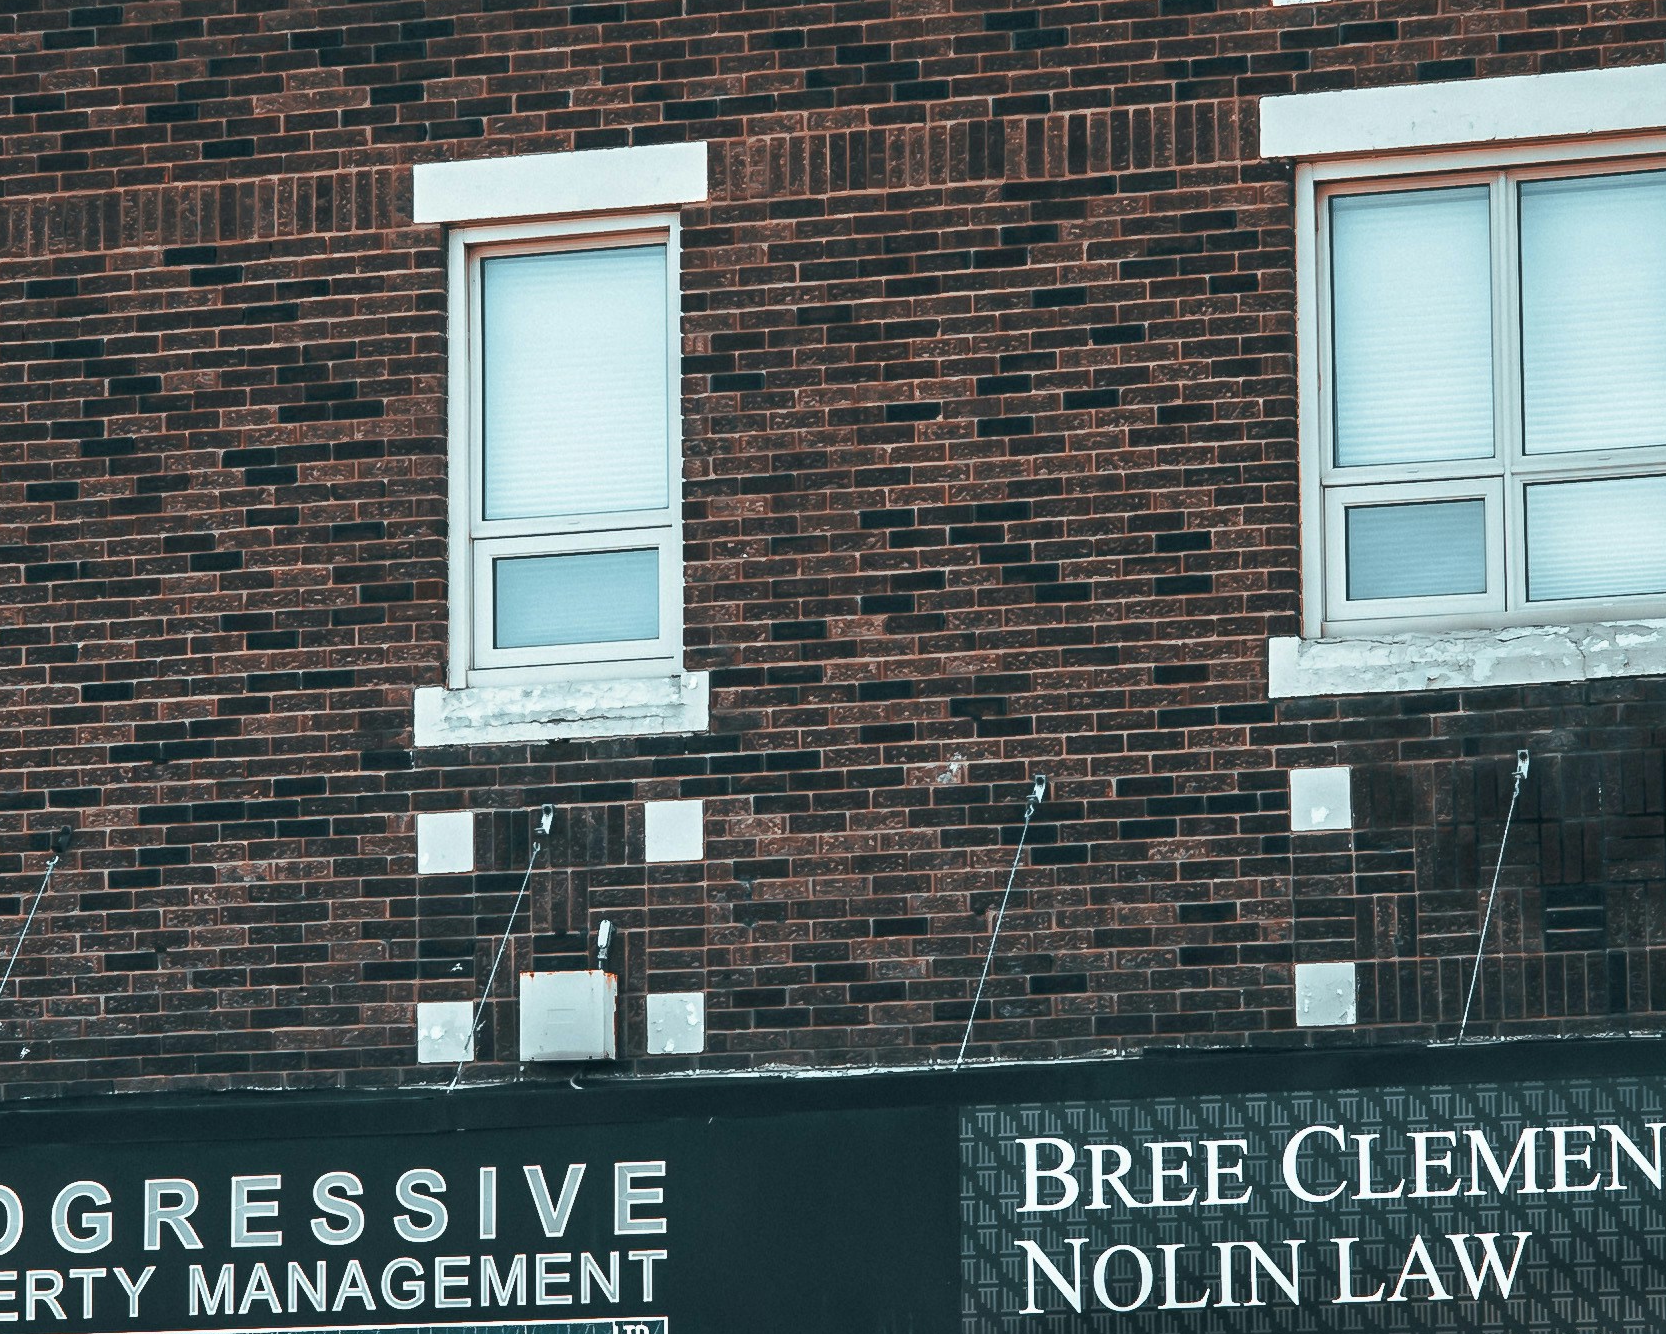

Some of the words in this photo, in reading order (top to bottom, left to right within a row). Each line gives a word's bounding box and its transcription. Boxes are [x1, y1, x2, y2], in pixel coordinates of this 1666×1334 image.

[1016, 1136, 1250, 1216] BREE
[188, 1248, 669, 1317] MANAGEMENT
[1016, 1238, 1302, 1316] NOLIN
[1332, 1231, 1531, 1304] LAW
